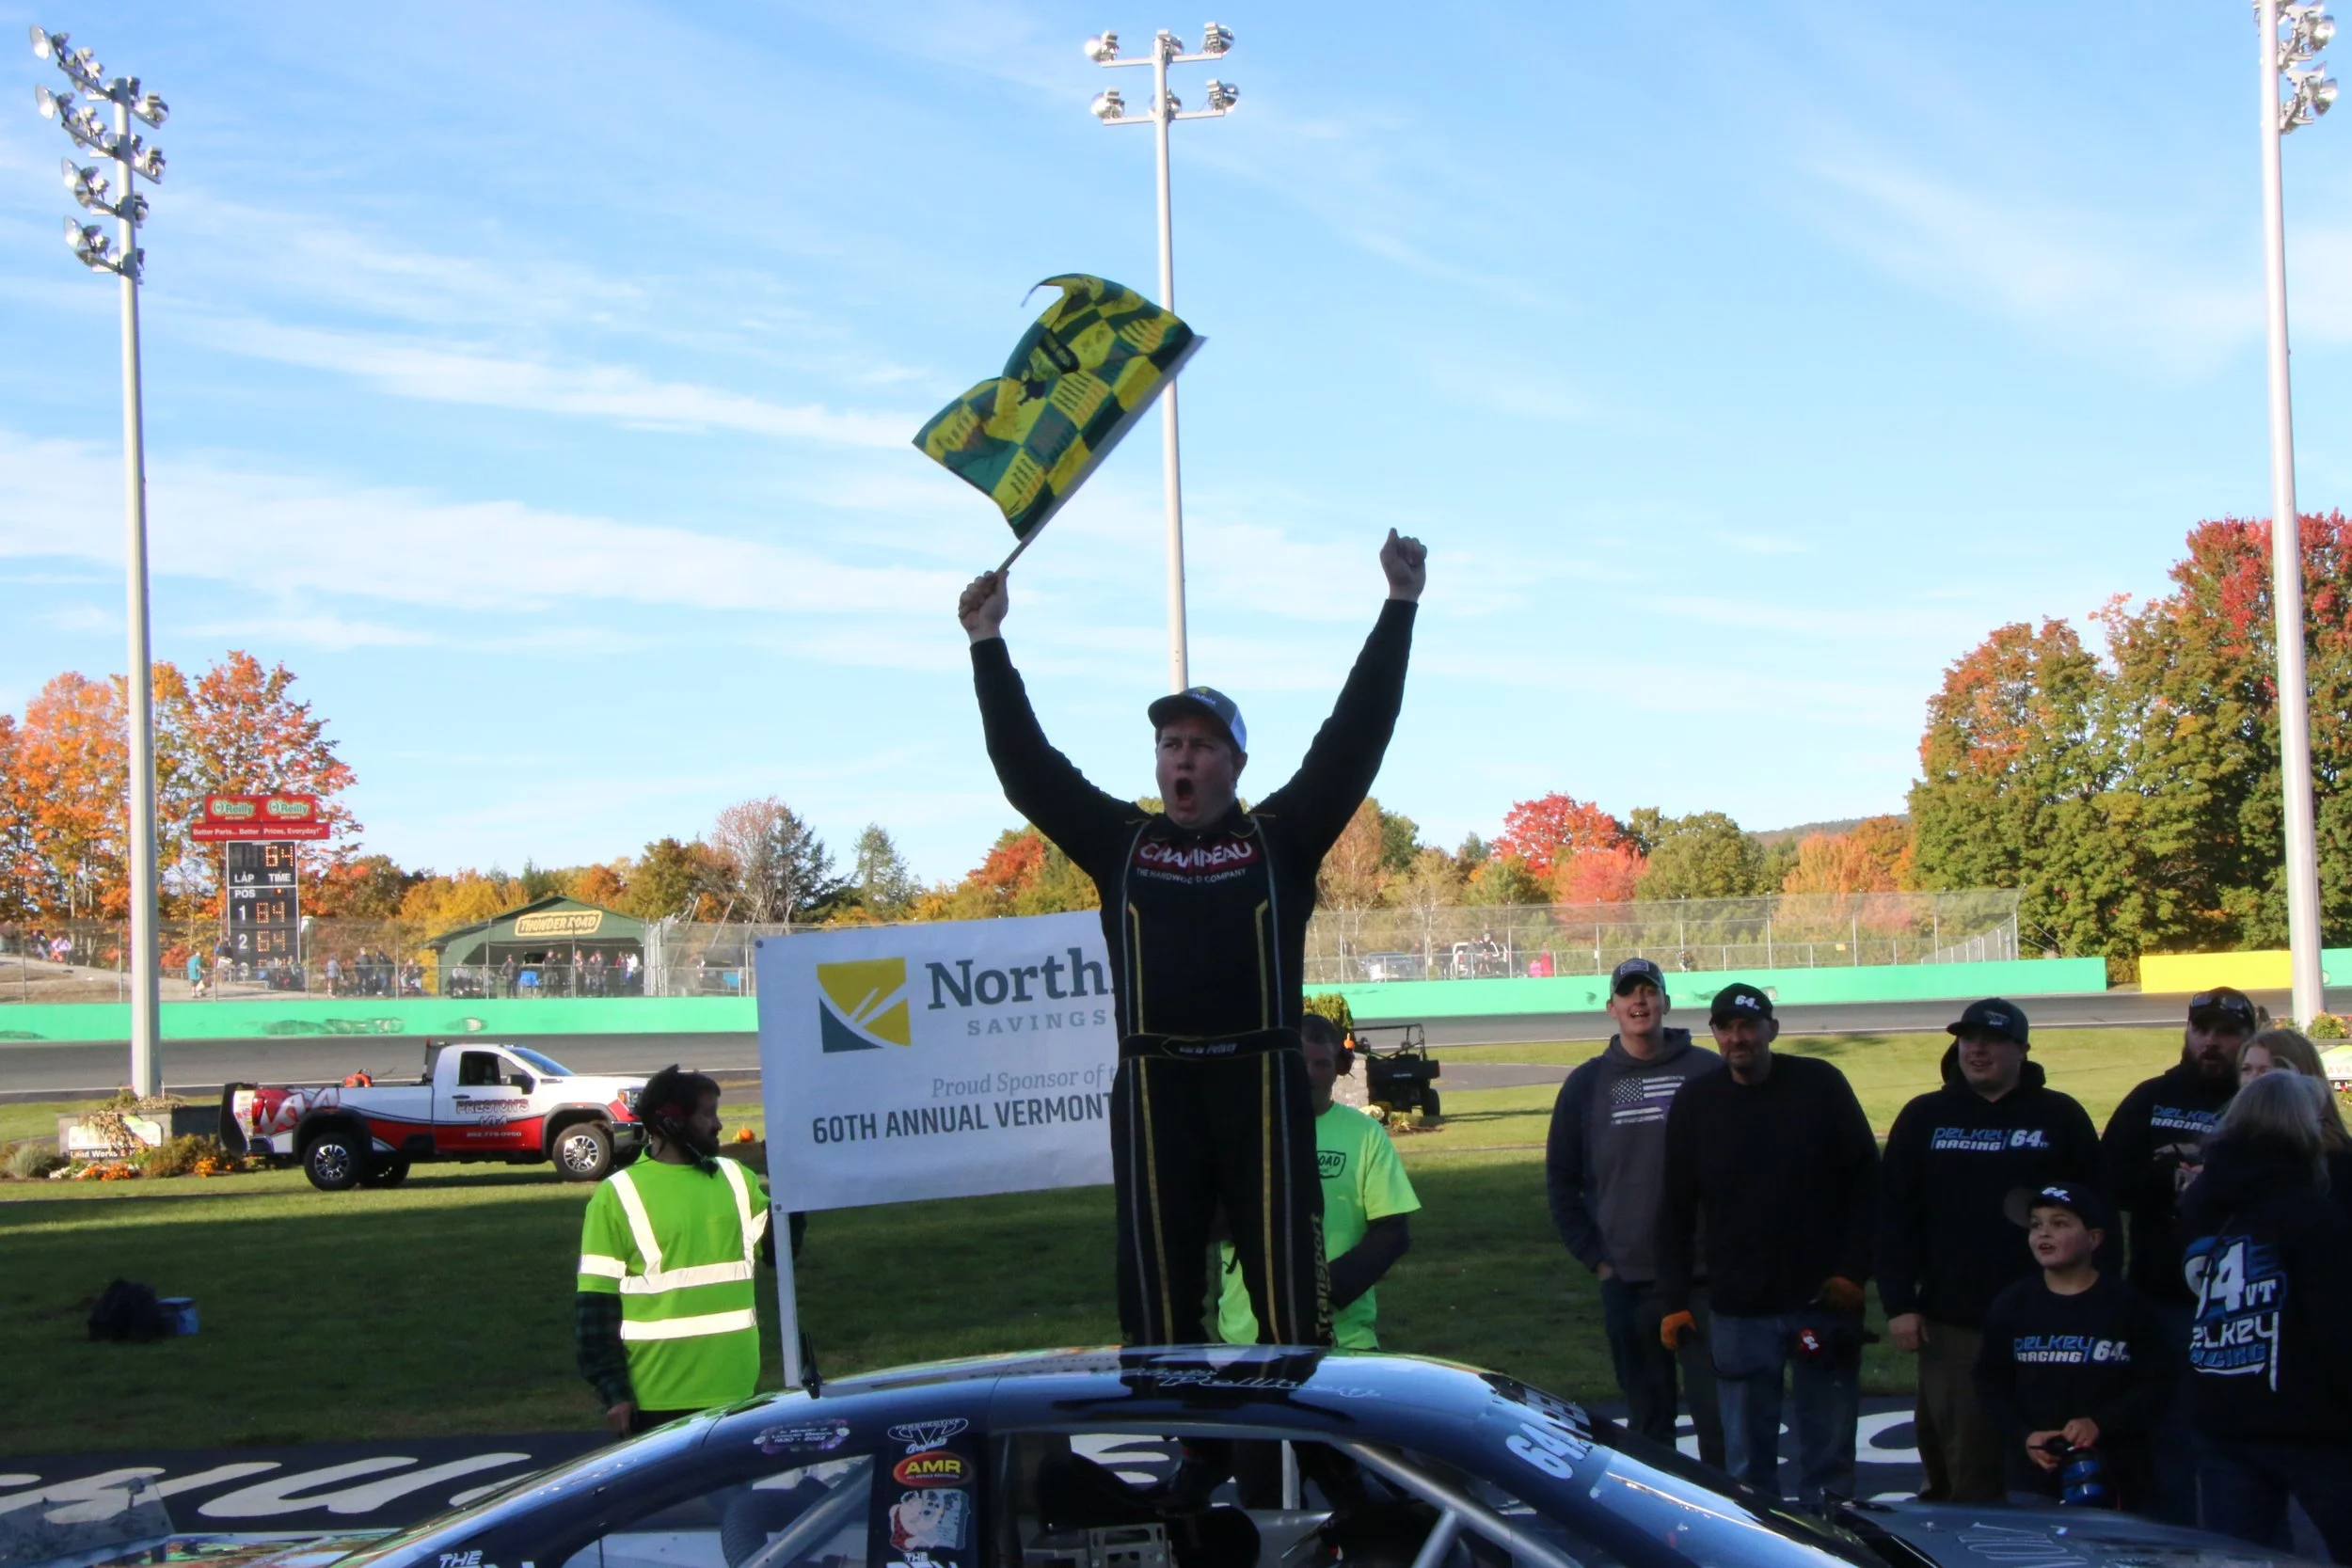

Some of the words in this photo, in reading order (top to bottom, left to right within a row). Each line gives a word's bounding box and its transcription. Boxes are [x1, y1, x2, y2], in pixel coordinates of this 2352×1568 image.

[265, 846, 294, 866] 64
[234, 875, 254, 883] LAP
[268, 873, 292, 882] TIME
[1204, 867, 1247, 884] COMPANY
[234, 889, 255, 898] POS
[521, 916, 565, 932] THUNDER
[567, 915, 597, 929] ROAD
[239, 934, 247, 949] 2
[967, 1008, 1106, 1037] SAVINGS
[931, 1072, 993, 1099] Proud
[996, 1069, 1079, 1097] Sponsor
[1083, 1063, 1106, 1092] of
[812, 1112, 877, 1145] 60TH
[885, 1103, 989, 1138] ANNUAL
[2151, 1117, 2214, 1133] RACING
[1935, 1140, 2002, 1151] RACING
[1317, 1155, 1341, 1166] OAD
[2016, 1351, 2082, 1363] RACING
[904, 1459, 961, 1475] AMR
[439, 1550, 484, 1568] THE
[903, 1551, 929, 1561] THE
